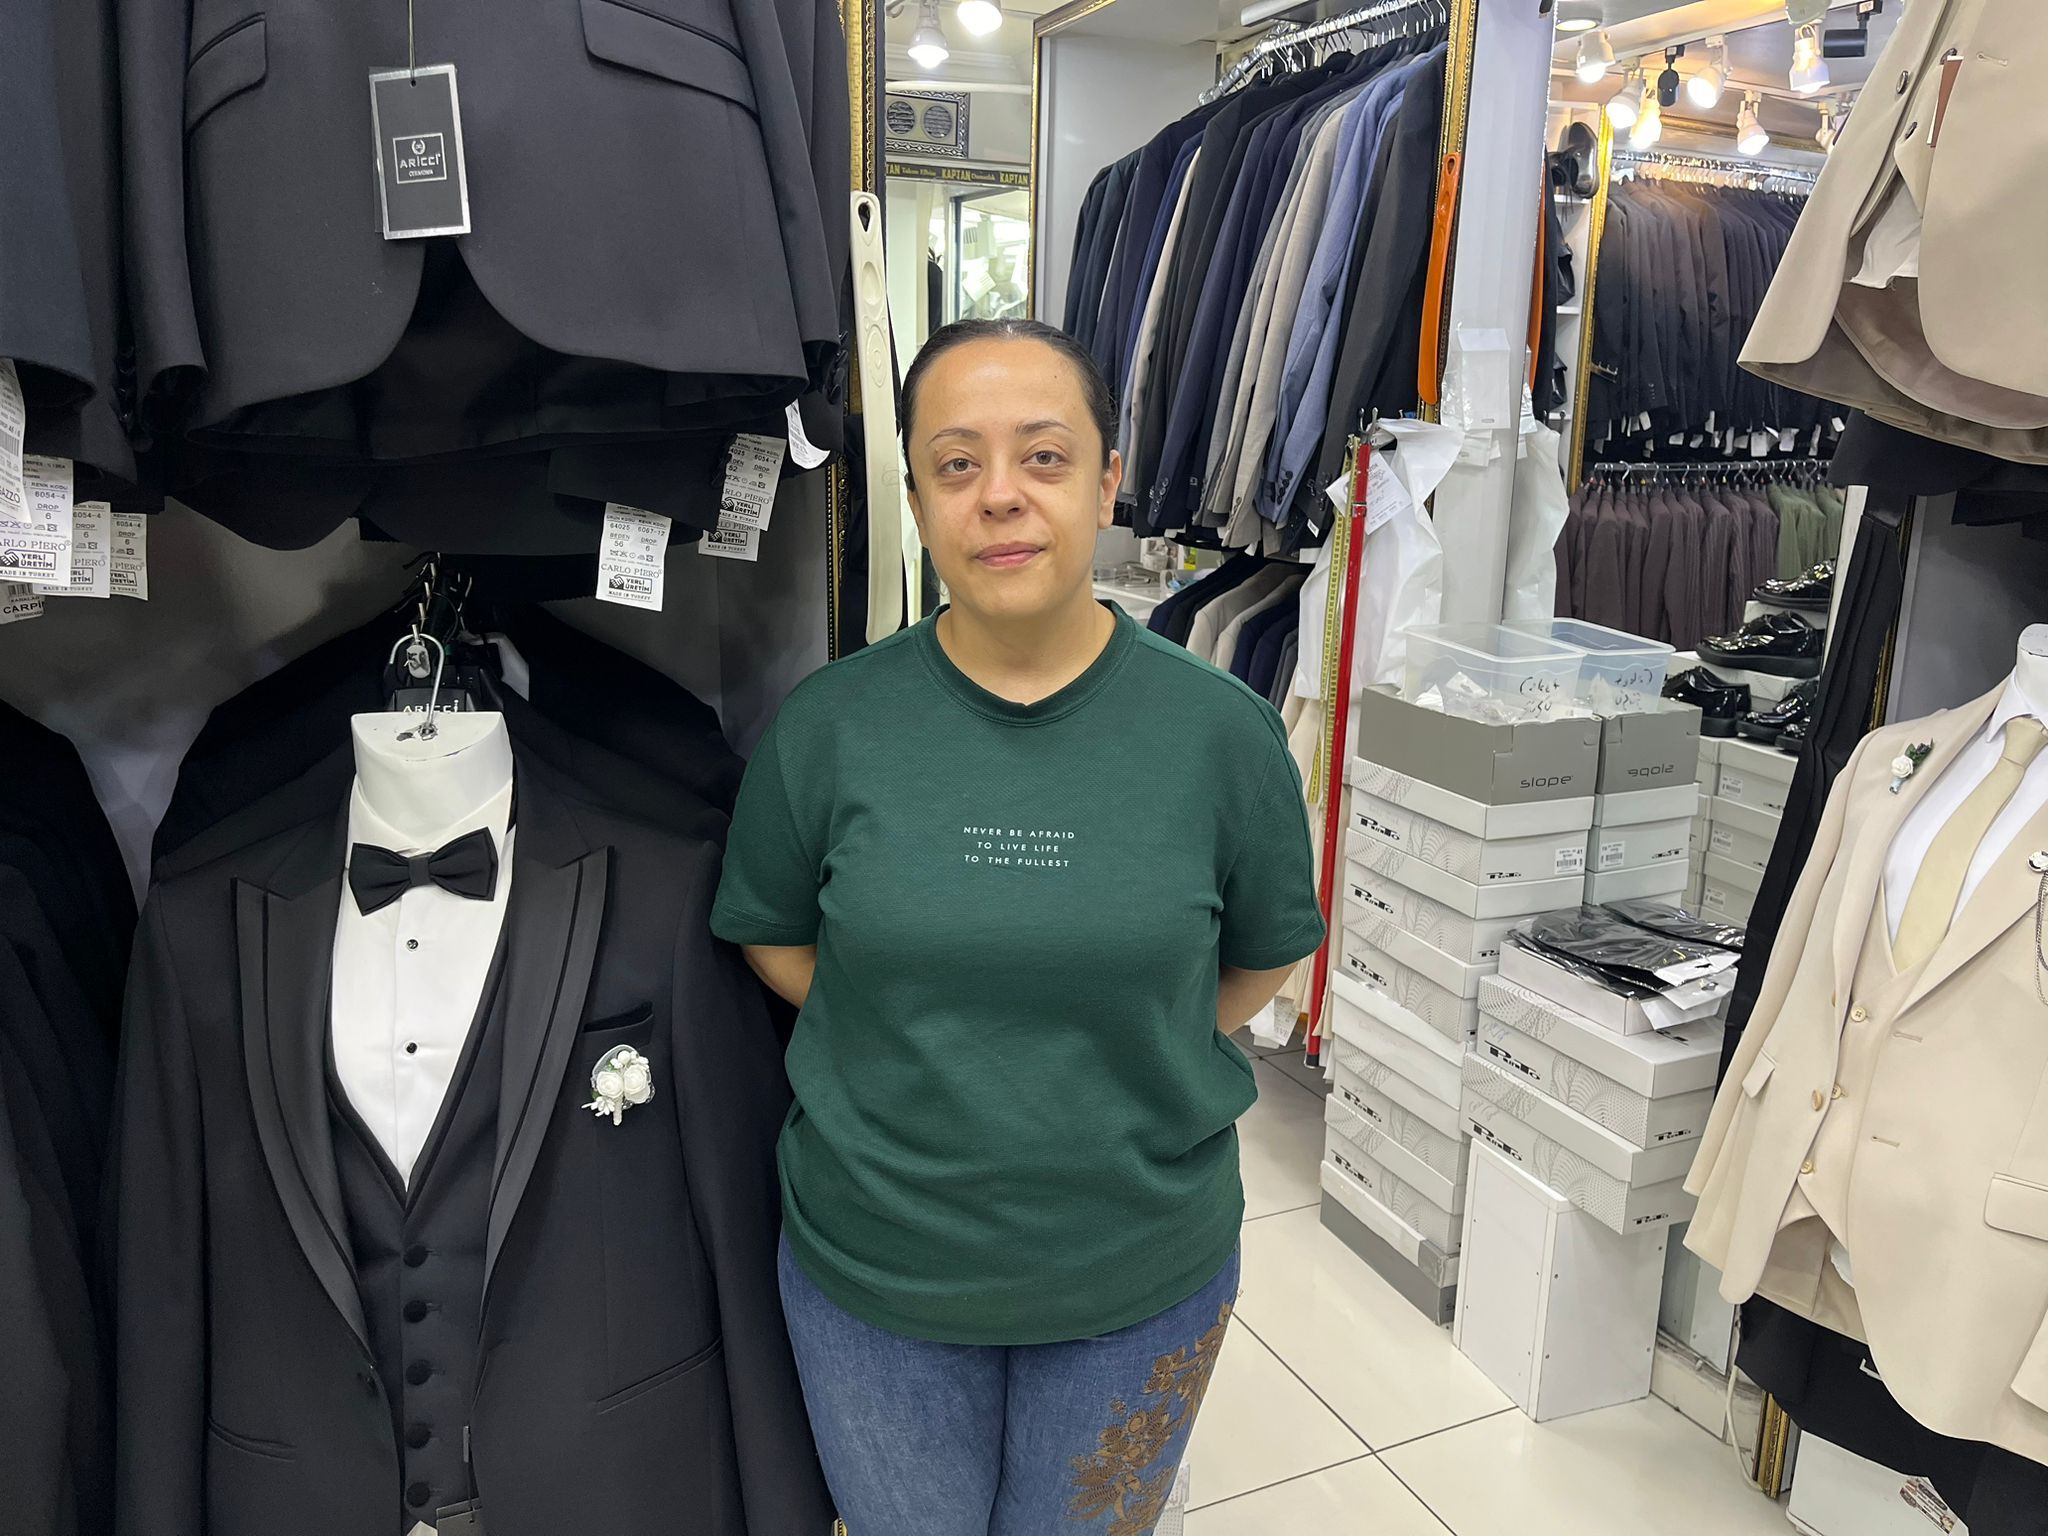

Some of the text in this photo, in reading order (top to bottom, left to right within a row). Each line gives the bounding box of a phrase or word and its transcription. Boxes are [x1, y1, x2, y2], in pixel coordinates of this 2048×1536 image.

[941, 168, 971, 181] KAPTAN
[1000, 172, 1028, 185] KAPTAN
[34, 490, 66, 500] 6054-4
[37, 502, 60, 510] DROP
[45, 512, 52, 520] 6
[600, 563, 632, 574] CARLO
[1520, 774, 1572, 789] slope
[963, 826, 1075, 839] NEVER BE AFRAID
[977, 841, 1059, 853] TO LIVE LIFE
[964, 854, 1070, 867] TO THE FULLEST
